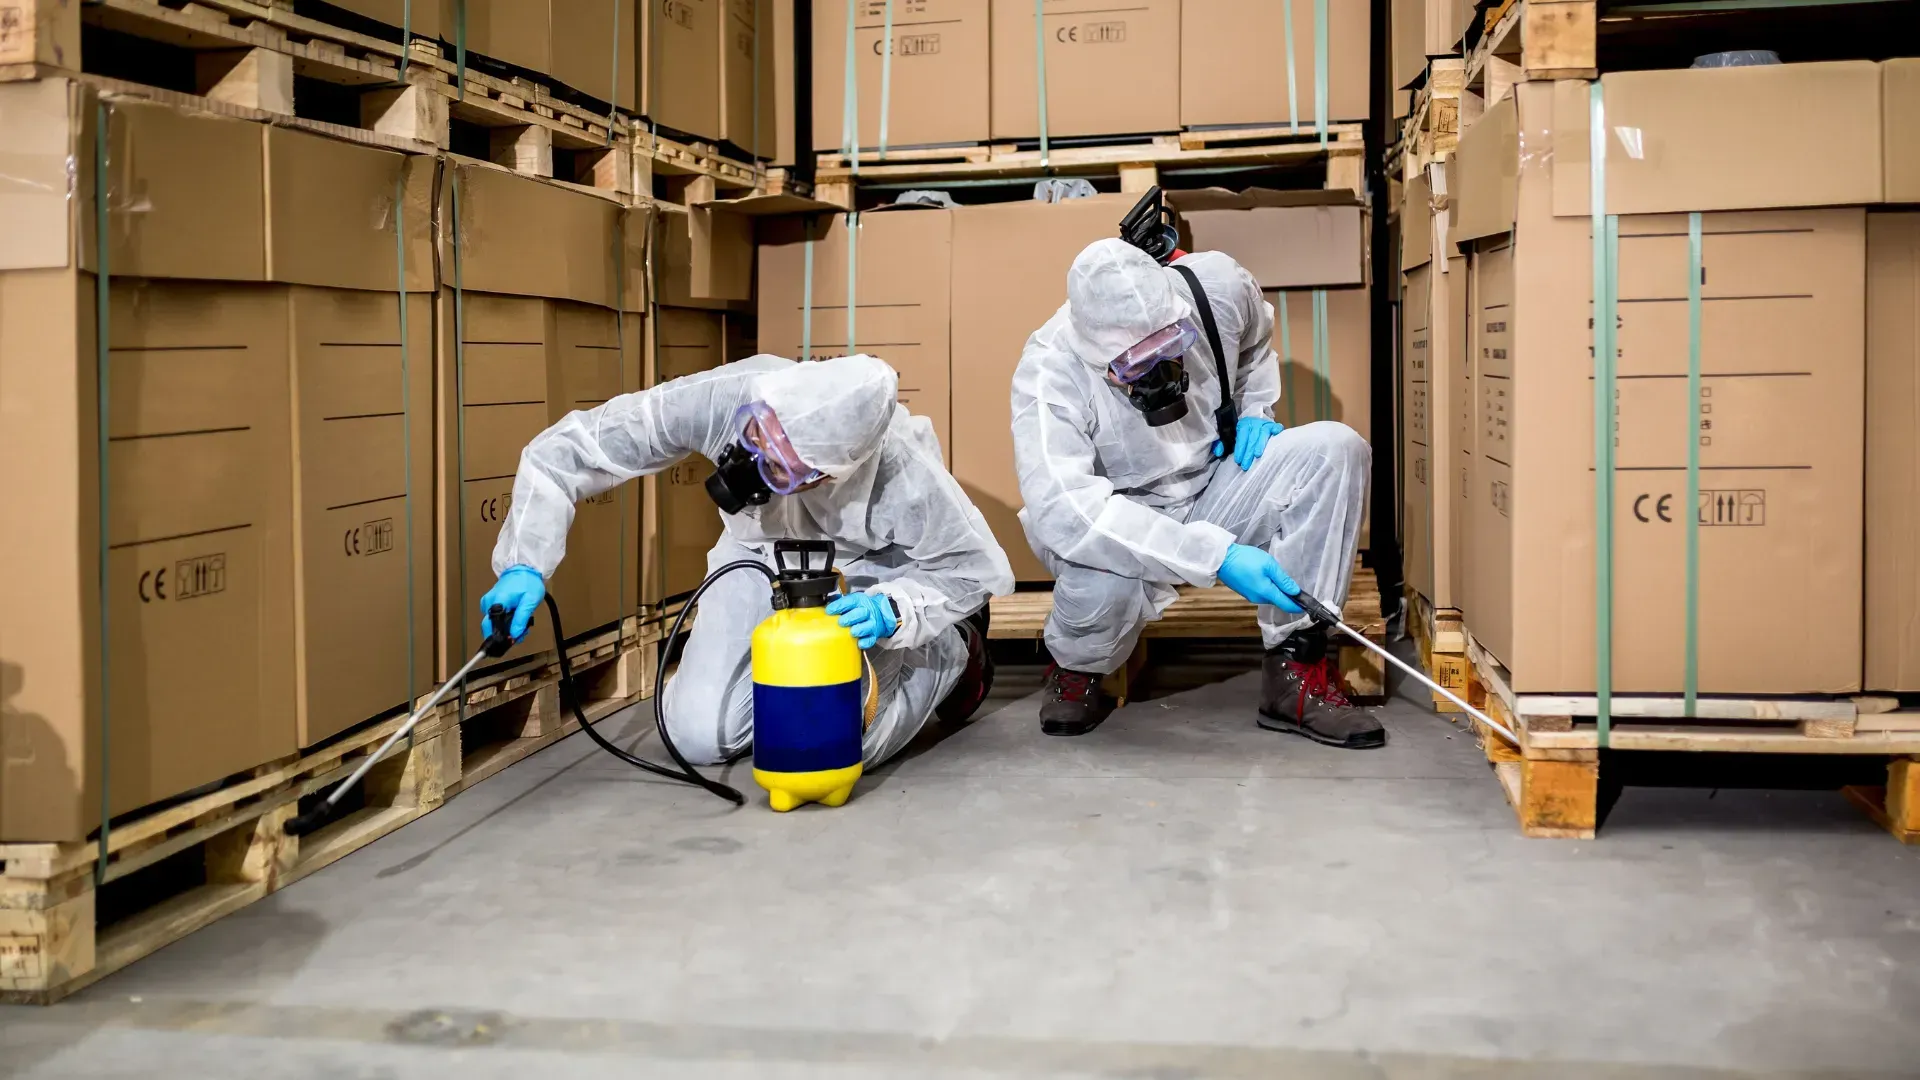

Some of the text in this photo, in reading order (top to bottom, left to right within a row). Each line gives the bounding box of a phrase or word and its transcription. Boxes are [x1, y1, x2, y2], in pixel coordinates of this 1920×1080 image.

[873, 38, 894, 56] C
[1056, 26, 1078, 43] CE
[670, 466, 680, 485] CE
[481, 497, 497, 522] CE
[1633, 493, 1673, 523] CE
[344, 528, 360, 557] CE
[138, 568, 166, 603] CE
